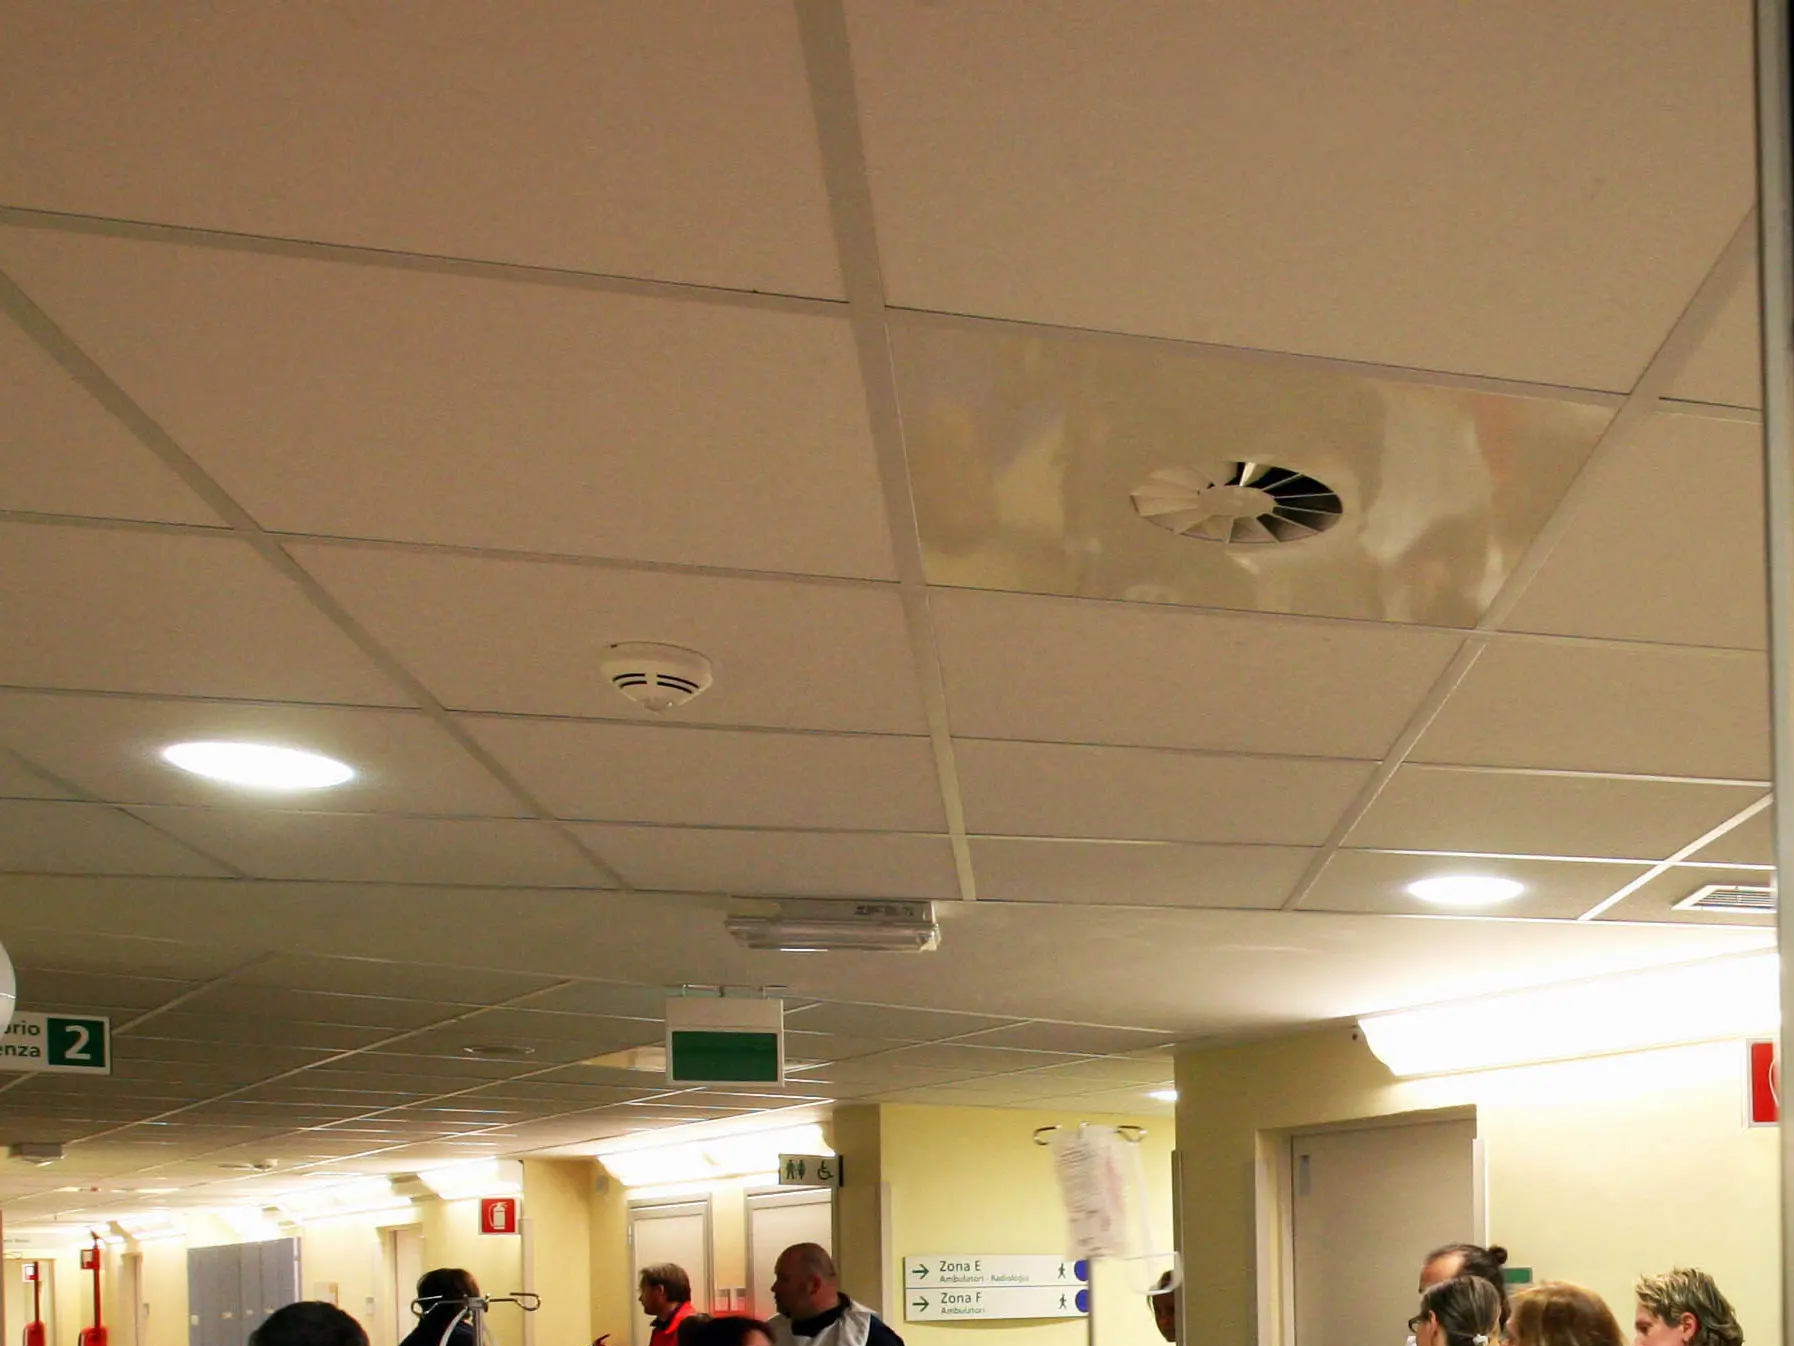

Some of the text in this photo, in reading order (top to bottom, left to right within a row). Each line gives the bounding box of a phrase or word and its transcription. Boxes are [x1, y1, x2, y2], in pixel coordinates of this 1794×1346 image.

[65, 1025, 91, 1060] 2
[939, 1260, 981, 1272] Zona E
[940, 1291, 982, 1304] Zona F
